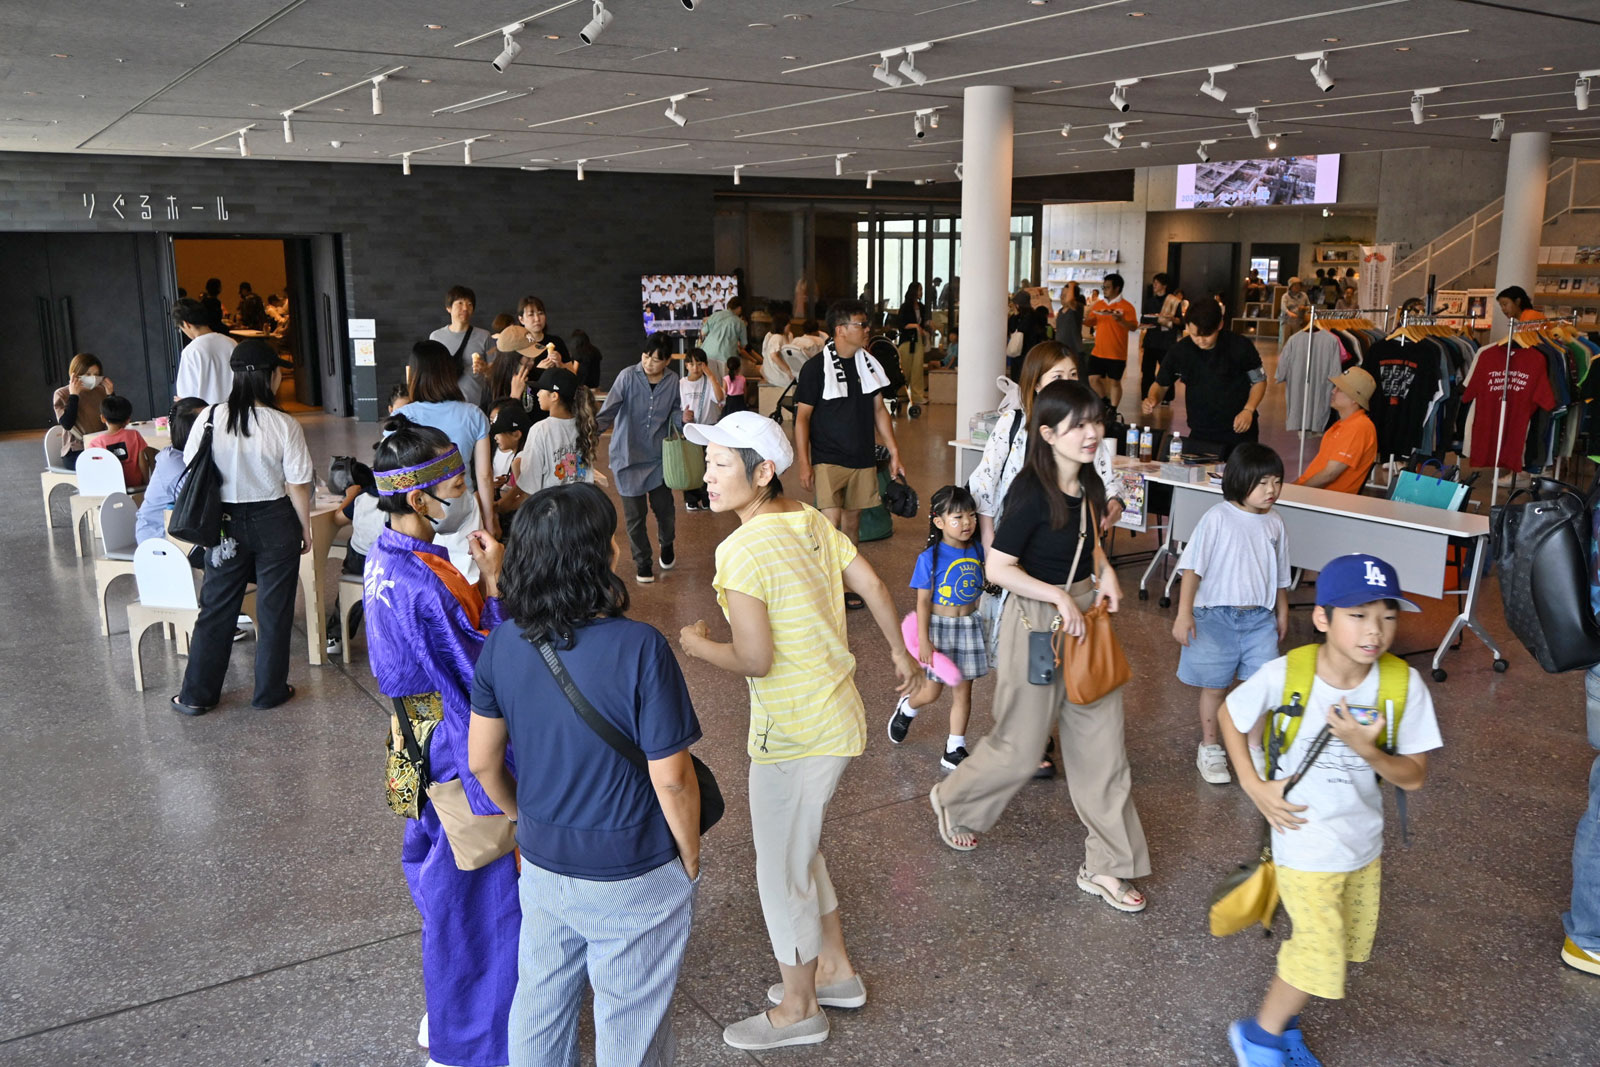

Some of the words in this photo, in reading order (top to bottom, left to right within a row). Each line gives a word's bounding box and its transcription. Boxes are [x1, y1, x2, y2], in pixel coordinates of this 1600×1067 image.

[83, 193, 229, 220] りぐるホール
[1363, 560, 1388, 587] LA
[540, 641, 561, 676] PUMA
